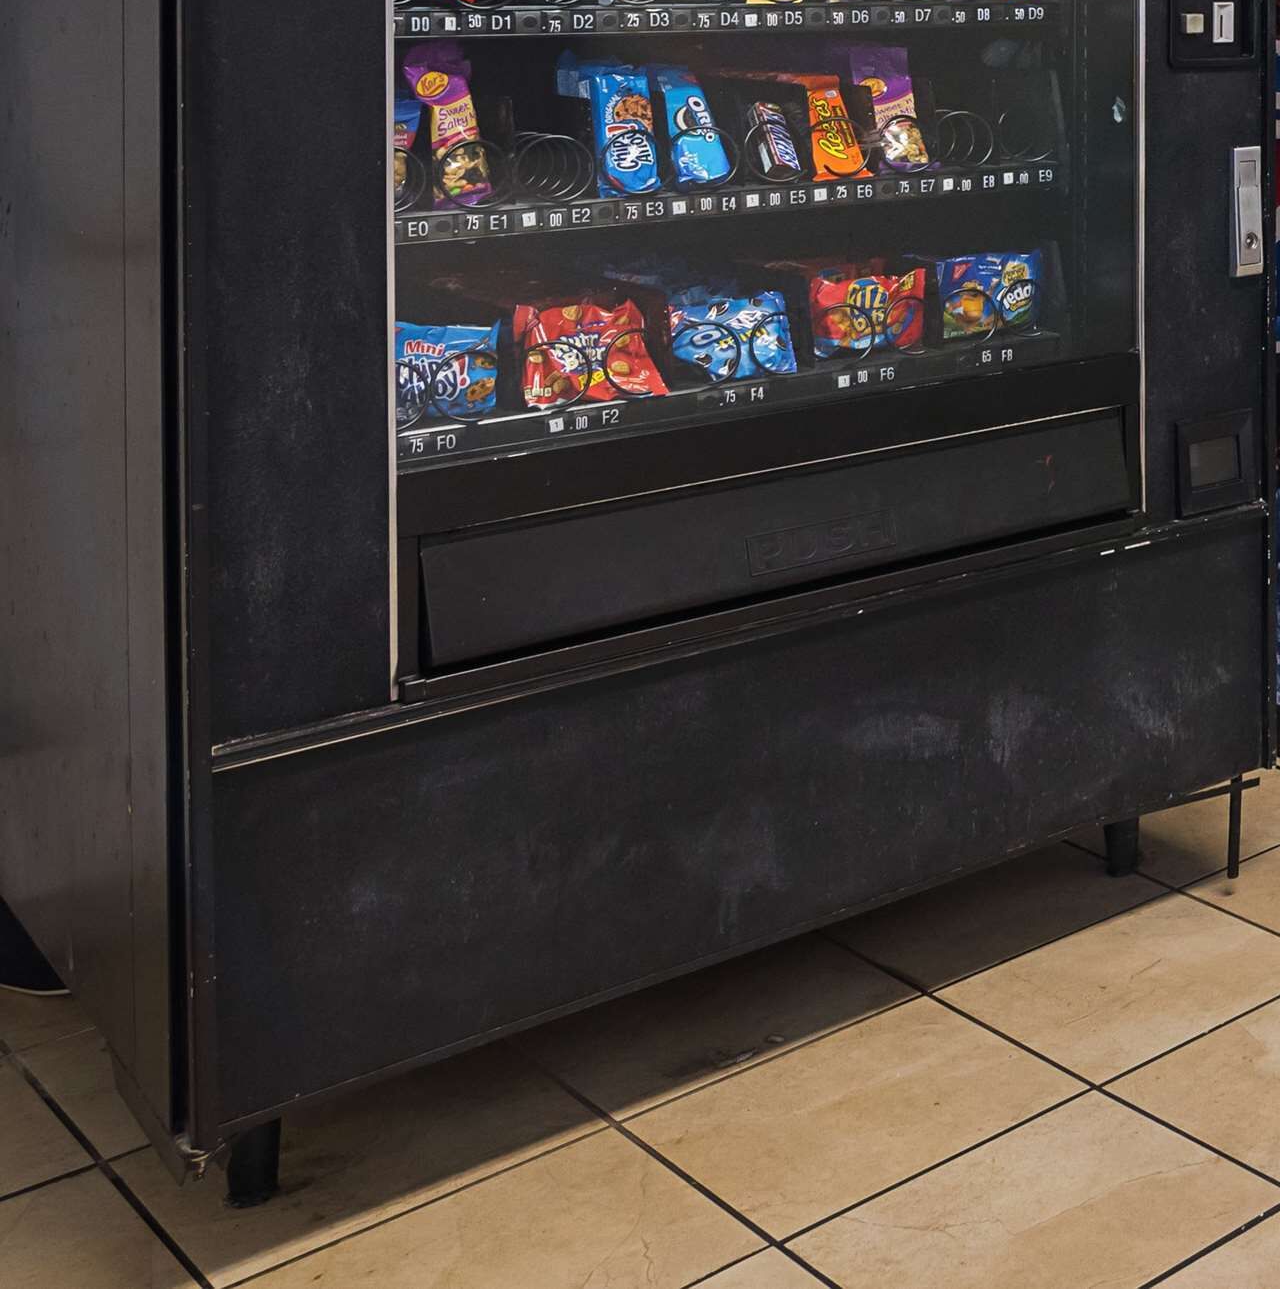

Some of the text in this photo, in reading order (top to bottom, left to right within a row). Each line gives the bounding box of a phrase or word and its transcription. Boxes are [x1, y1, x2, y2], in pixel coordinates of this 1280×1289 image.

[650, 12, 669, 27] D3
[720, 12, 739, 26] D4
[785, 11, 803, 25] D5
[852, 10, 869, 23] D6
[915, 9, 931, 22] D7
[977, 8, 990, 21] D8
[1028, 7, 1044, 20] D9
[411, 16, 429, 32] D0
[491, 15, 511, 30] D1
[574, 15, 594, 29] D2
[983, 175, 995, 188] E8
[1039, 169, 1053, 182] E9
[857, 184, 873, 199] E6
[921, 179, 935, 193] E7
[722, 196, 736, 211] E4
[790, 190, 807, 204] E5
[572, 208, 591, 224] E2
[646, 202, 664, 217] E3
[408, 221, 429, 237] E0
[490, 214, 508, 230] E1
[405, 339, 445, 357] Mini
[1002, 348, 1013, 362] F8
[879, 367, 895, 381] F6
[751, 387, 764, 401] F4
[602, 409, 619, 425] F2
[437, 434, 456, 451] F0
